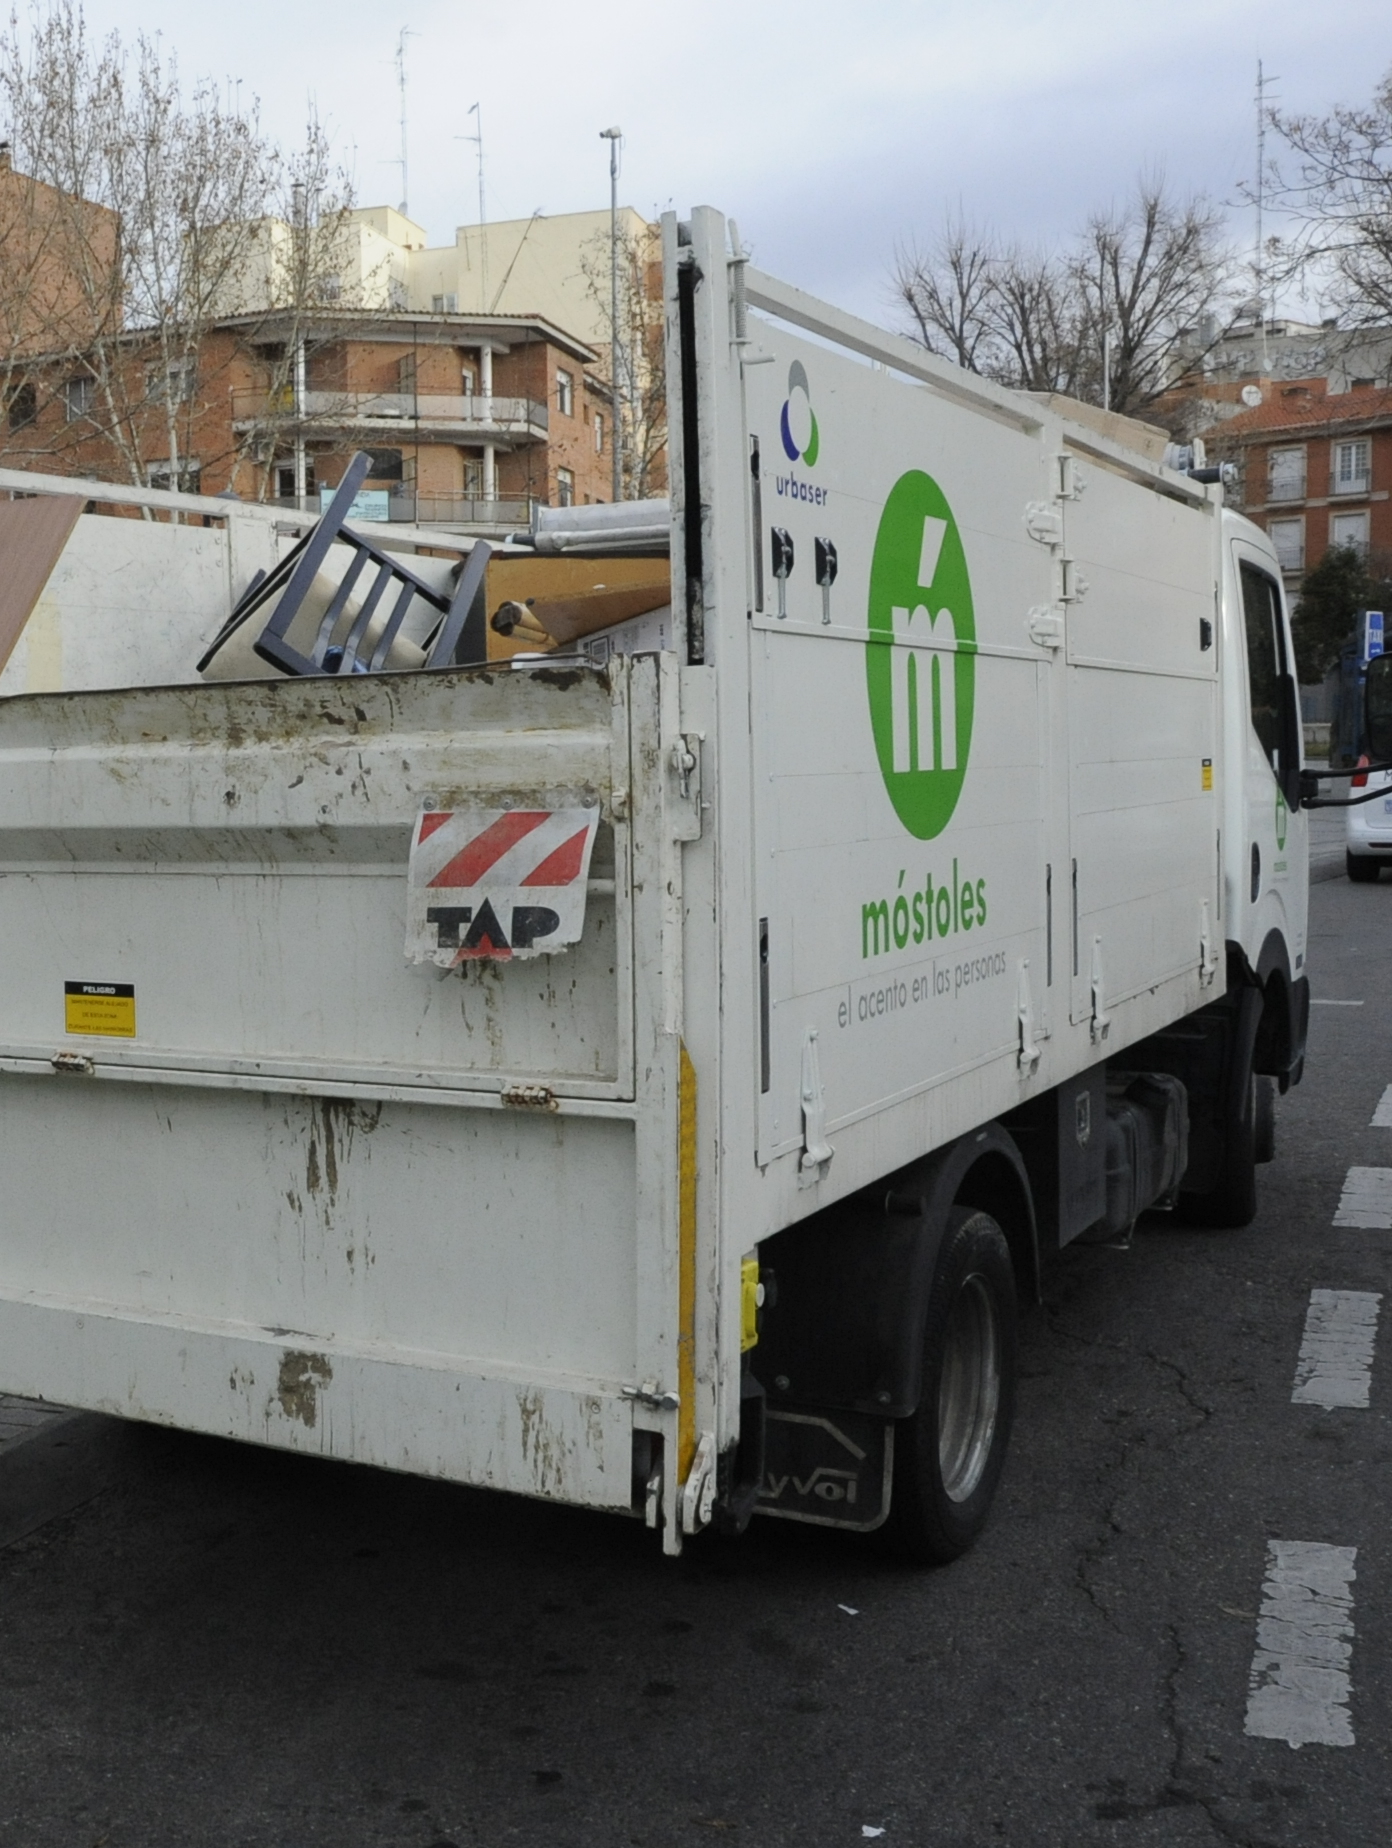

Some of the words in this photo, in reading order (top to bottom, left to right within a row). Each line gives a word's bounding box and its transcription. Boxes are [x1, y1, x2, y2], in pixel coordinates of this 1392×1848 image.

[776, 471, 828, 507] urbaser
[426, 896, 561, 949] TAP
[861, 857, 987, 959] móstoles
[83, 985, 116, 995] PELIGRO
[837, 984, 852, 1029] el
[858, 978, 907, 1022] acento
[912, 975, 928, 1004] en
[932, 960, 951, 998] las
[954, 951, 1006, 1000] personas
